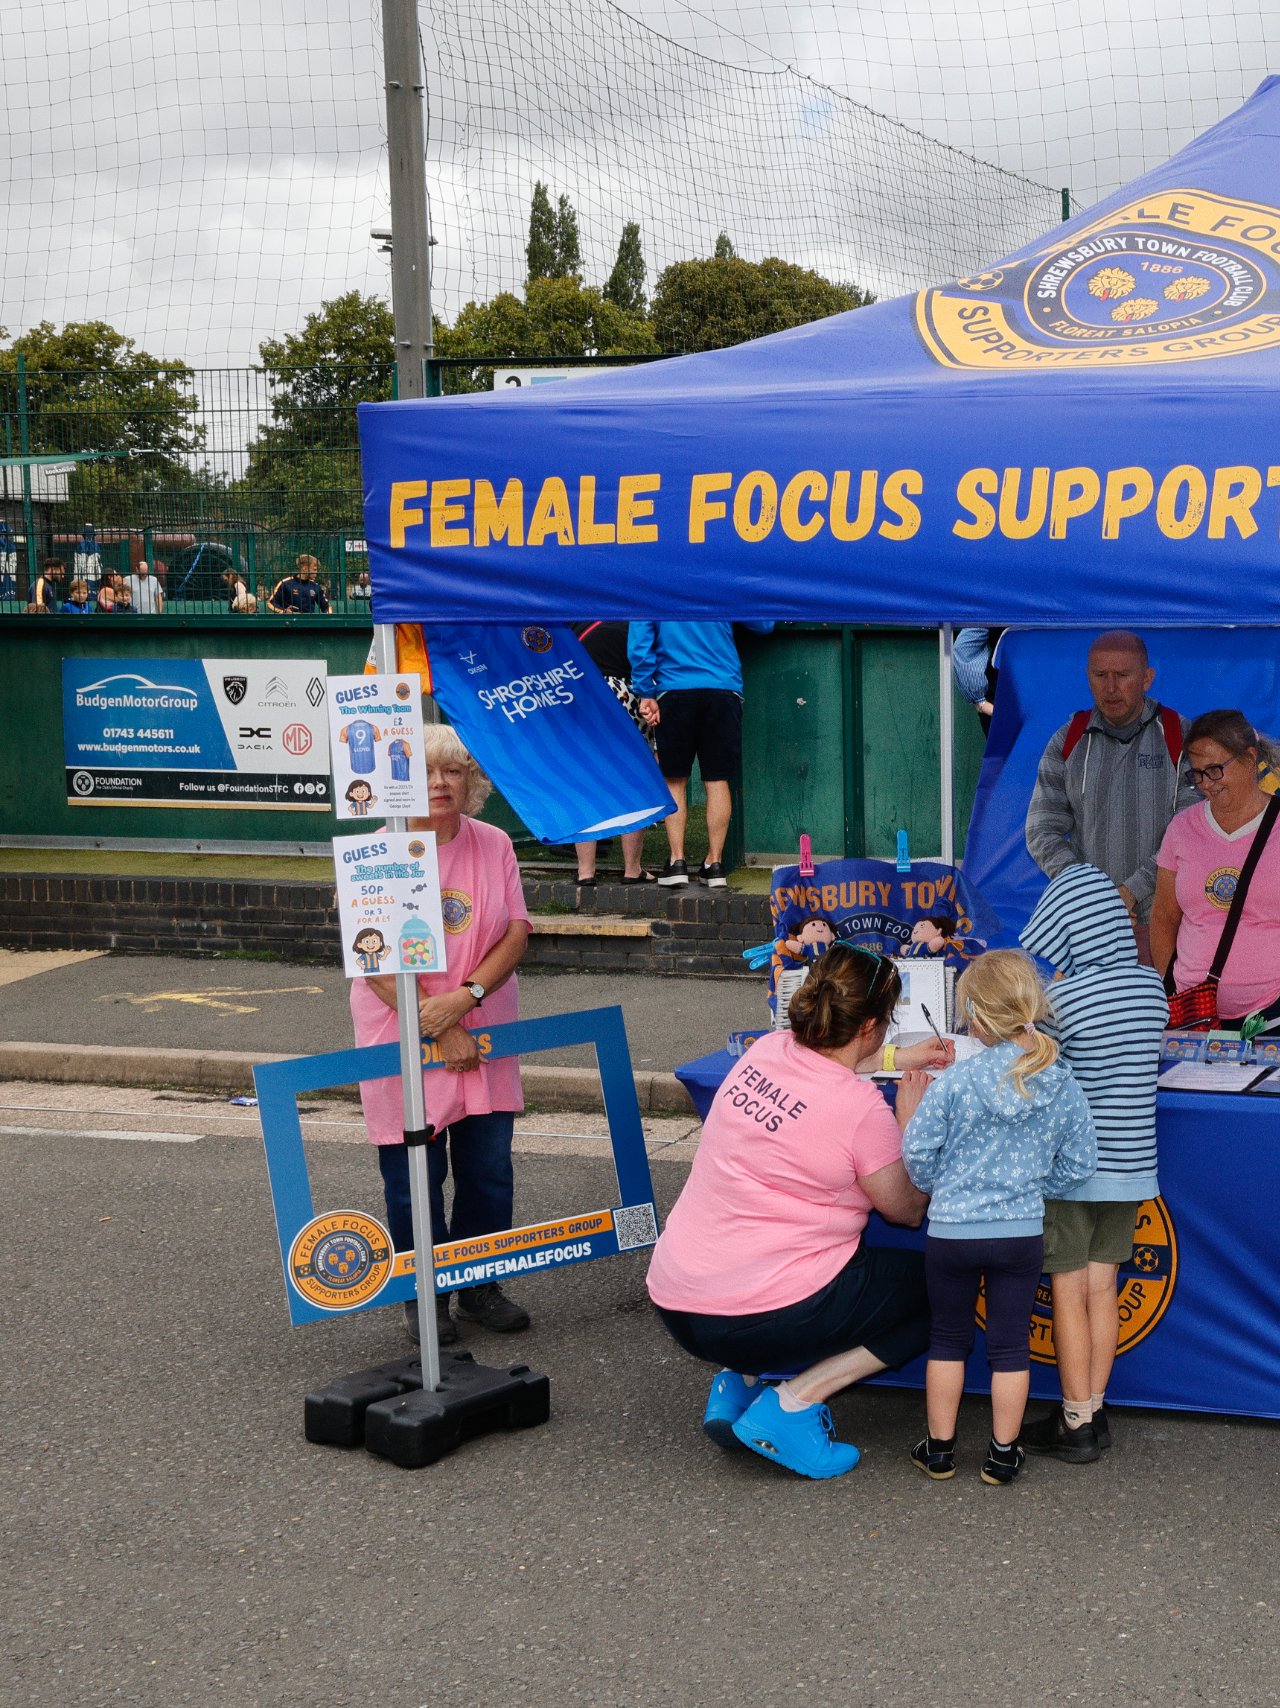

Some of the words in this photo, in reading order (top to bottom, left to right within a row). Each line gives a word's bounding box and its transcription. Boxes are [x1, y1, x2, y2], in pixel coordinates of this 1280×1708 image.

[1037, 237, 1128, 299] SHREWSBURY
[1134, 237, 1191, 258] TOWN
[1192, 250, 1253, 286] FOOTBALL
[1223, 285, 1254, 307] CLUB
[1140, 261, 1184, 274] 1886
[957, 305, 1149, 364] SUPPORTERS
[1049, 320, 1117, 338] FLOREAT
[1121, 318, 1203, 336] SALOPIA
[391, 475, 660, 548] FEMALE
[690, 471, 922, 542] FOCUS
[335, 684, 379, 704] GUESS
[478, 659, 584, 710] SHROPSHIRE
[76, 694, 198, 710] BudgenMotorGroup
[339, 705, 357, 715] The
[358, 704, 392, 715] Winning
[392, 704, 412, 712] Team
[501, 685, 574, 723] HOMES
[103, 728, 135, 739] 01743
[137, 728, 174, 739] 445611
[286, 727, 309, 751] MG
[355, 729, 367, 745] 9
[383, 728, 389, 736] A
[391, 727, 414, 736] GUESS
[78, 742, 200, 755] www.budgenmotors.co.uk
[95, 777, 142, 786] FOUNDATION
[180, 782, 204, 792] Follow
[217, 783, 289, 794] @FoundationSTFC
[343, 842, 388, 864] GUESS
[355, 864, 373, 874] The
[374, 862, 408, 872] number
[410, 861, 419, 870] of
[352, 898, 358, 907] A
[362, 895, 395, 906] GUESS
[770, 880, 892, 917] EWSBURY
[357, 917, 372, 925] FOR
[844, 917, 882, 934] TOWN
[738, 1065, 808, 1121] FEMALE
[723, 1085, 785, 1134] FOCUS
[300, 1221, 339, 1258] FEMALE
[343, 1219, 380, 1245] FOCUS
[404, 1250, 450, 1270] FELE
[454, 1244, 490, 1259] FOCUS
[494, 1226, 565, 1250] SUPPORTERS
[569, 1218, 603, 1234] GROUP
[414, 1241, 592, 1290] OLLOWFEMALEFOCUS
[306, 1278, 360, 1299] SUPPORTERS
[360, 1264, 381, 1291] GROUP
